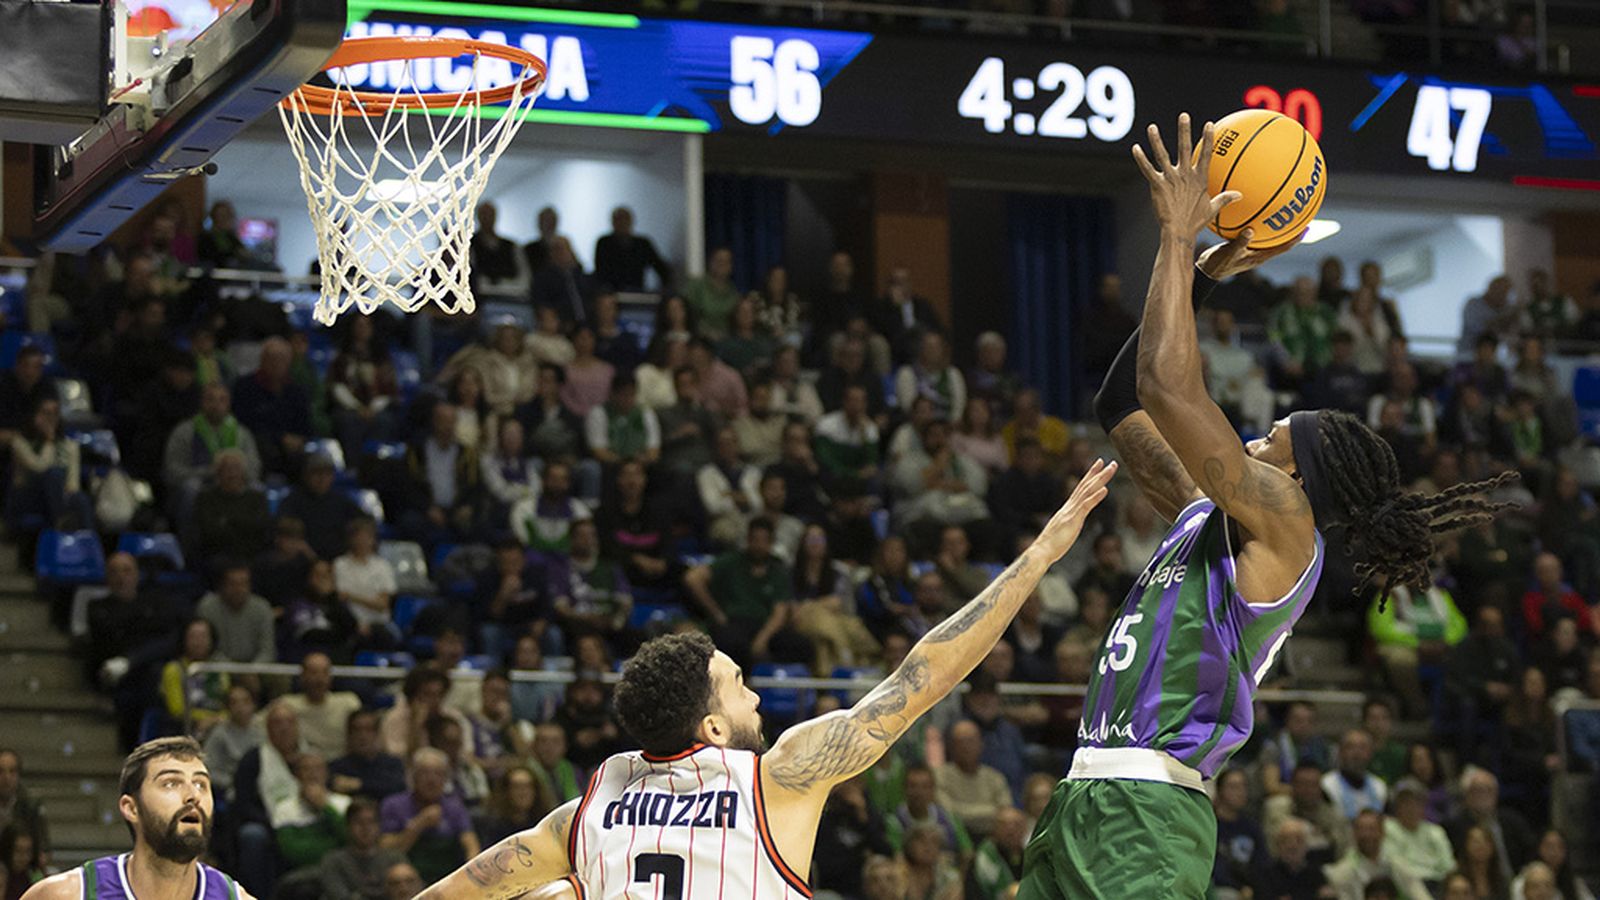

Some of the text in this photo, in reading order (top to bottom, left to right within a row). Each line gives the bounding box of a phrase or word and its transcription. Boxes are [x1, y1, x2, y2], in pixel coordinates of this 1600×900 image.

[729, 36, 822, 126] 56
[957, 57, 1136, 142] 4:29
[1216, 129, 1240, 157] FIBA
[1406, 84, 1492, 172] 47
[1262, 155, 1323, 231] Wilson
